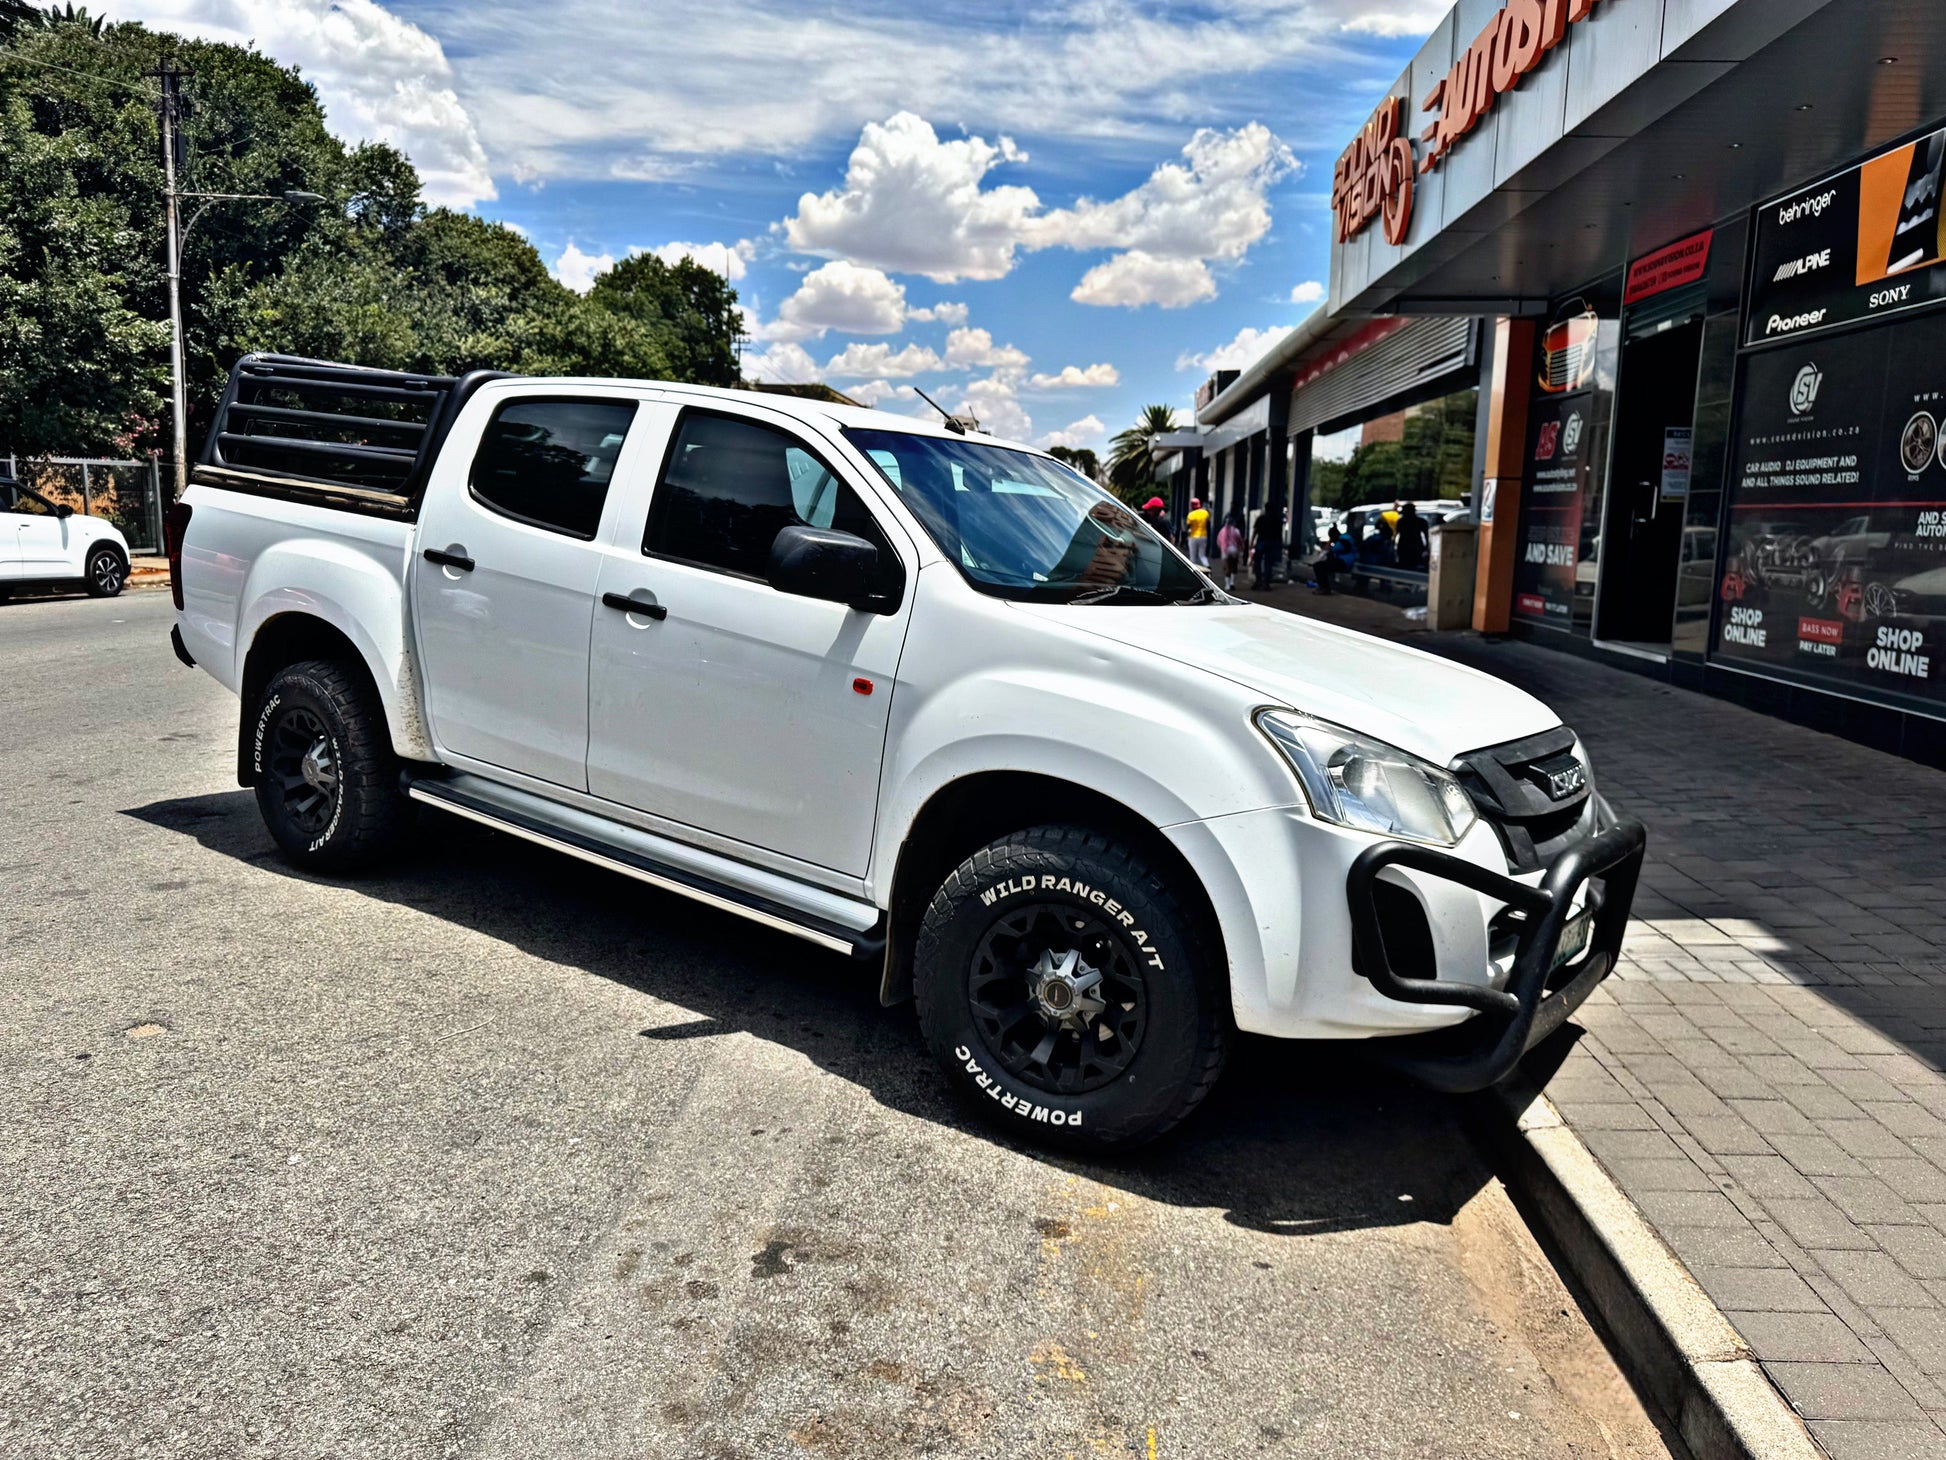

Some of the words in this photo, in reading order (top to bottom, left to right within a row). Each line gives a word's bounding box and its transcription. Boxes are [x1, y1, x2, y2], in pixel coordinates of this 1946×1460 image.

[1432, 0, 1593, 158] AUTOS
[1332, 96, 1398, 209] SOUND
[1337, 153, 1392, 243] VISION
[1779, 190, 1836, 225] behringer
[1782, 248, 1831, 279] ALPINE
[1869, 285, 1910, 308] SONY
[1766, 308, 1827, 334] Pioneer
[1746, 463, 1760, 473] CAR
[1760, 461, 1781, 473] AUDIO
[1785, 460, 1795, 471] DJ
[1795, 457, 1838, 470] EQUIPMENT
[1839, 455, 1858, 468] AND
[1742, 477, 1756, 488] AND
[1756, 476, 1769, 487] ALL
[1770, 475, 1794, 487] THINGS
[1795, 473, 1821, 486] SOUND
[1822, 471, 1860, 484] RELATED!
[1917, 511, 1939, 524] AND
[1525, 542, 1546, 564] AND
[1546, 544, 1574, 567] SAVE
[1730, 606, 1763, 627] SHOP
[1724, 625, 1767, 648] ONLINE
[1821, 625, 1839, 638] NOW
[1876, 626, 1923, 652] SHOP
[1799, 640, 1813, 653] PAY
[1813, 642, 1837, 657] LATER
[1867, 647, 1930, 678] ONLINE
[254, 694, 281, 773] POWERTRAC
[980, 874, 1036, 907] WILD
[1041, 874, 1136, 930] RANGER
[955, 1045, 1083, 1127] POWERTRAC
